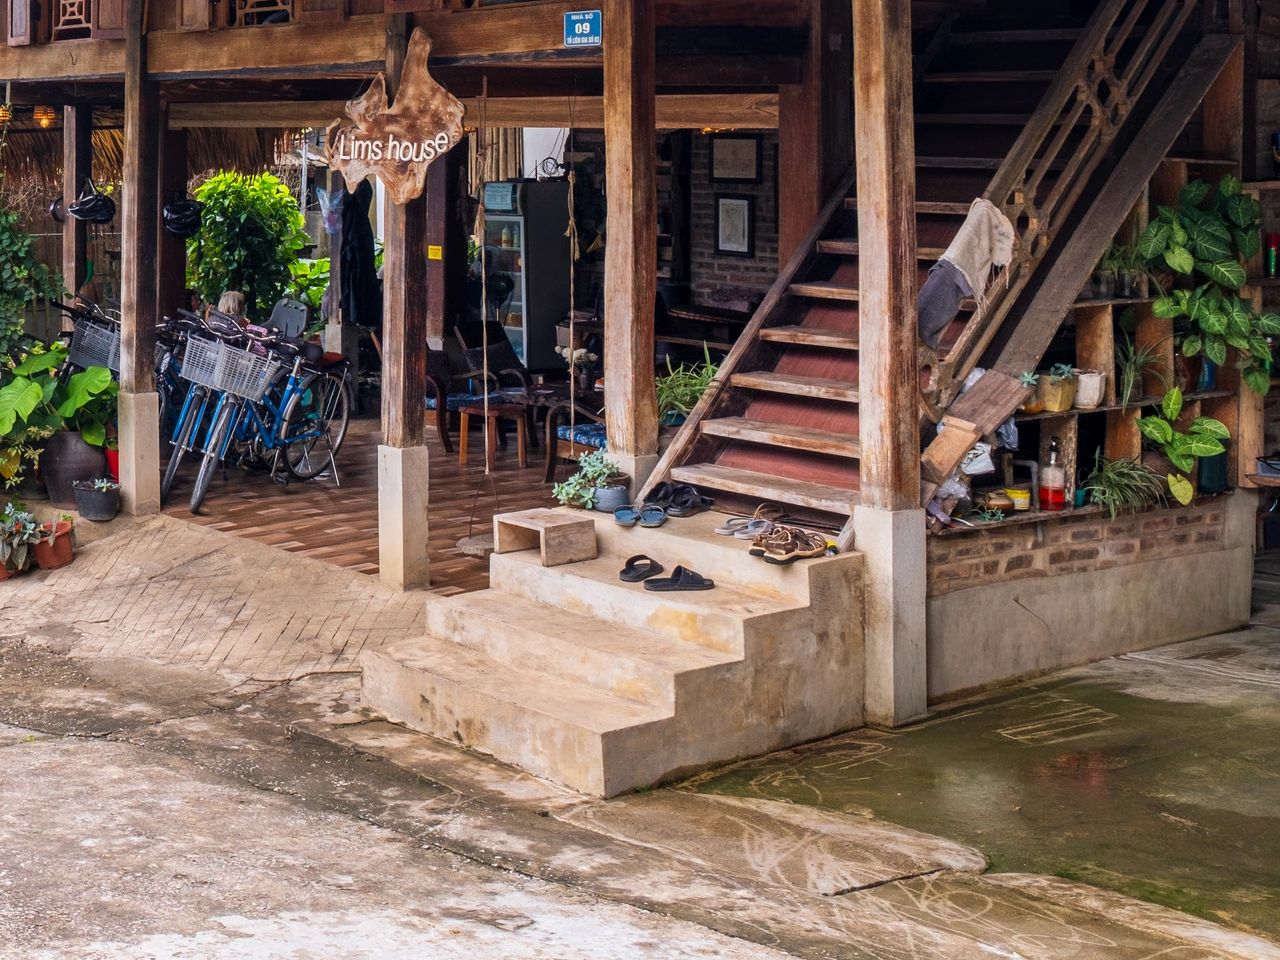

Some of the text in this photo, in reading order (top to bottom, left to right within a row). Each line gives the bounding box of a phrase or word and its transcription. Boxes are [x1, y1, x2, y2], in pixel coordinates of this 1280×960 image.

[575, 22, 590, 34] 09
[340, 132, 449, 162] Lims house
